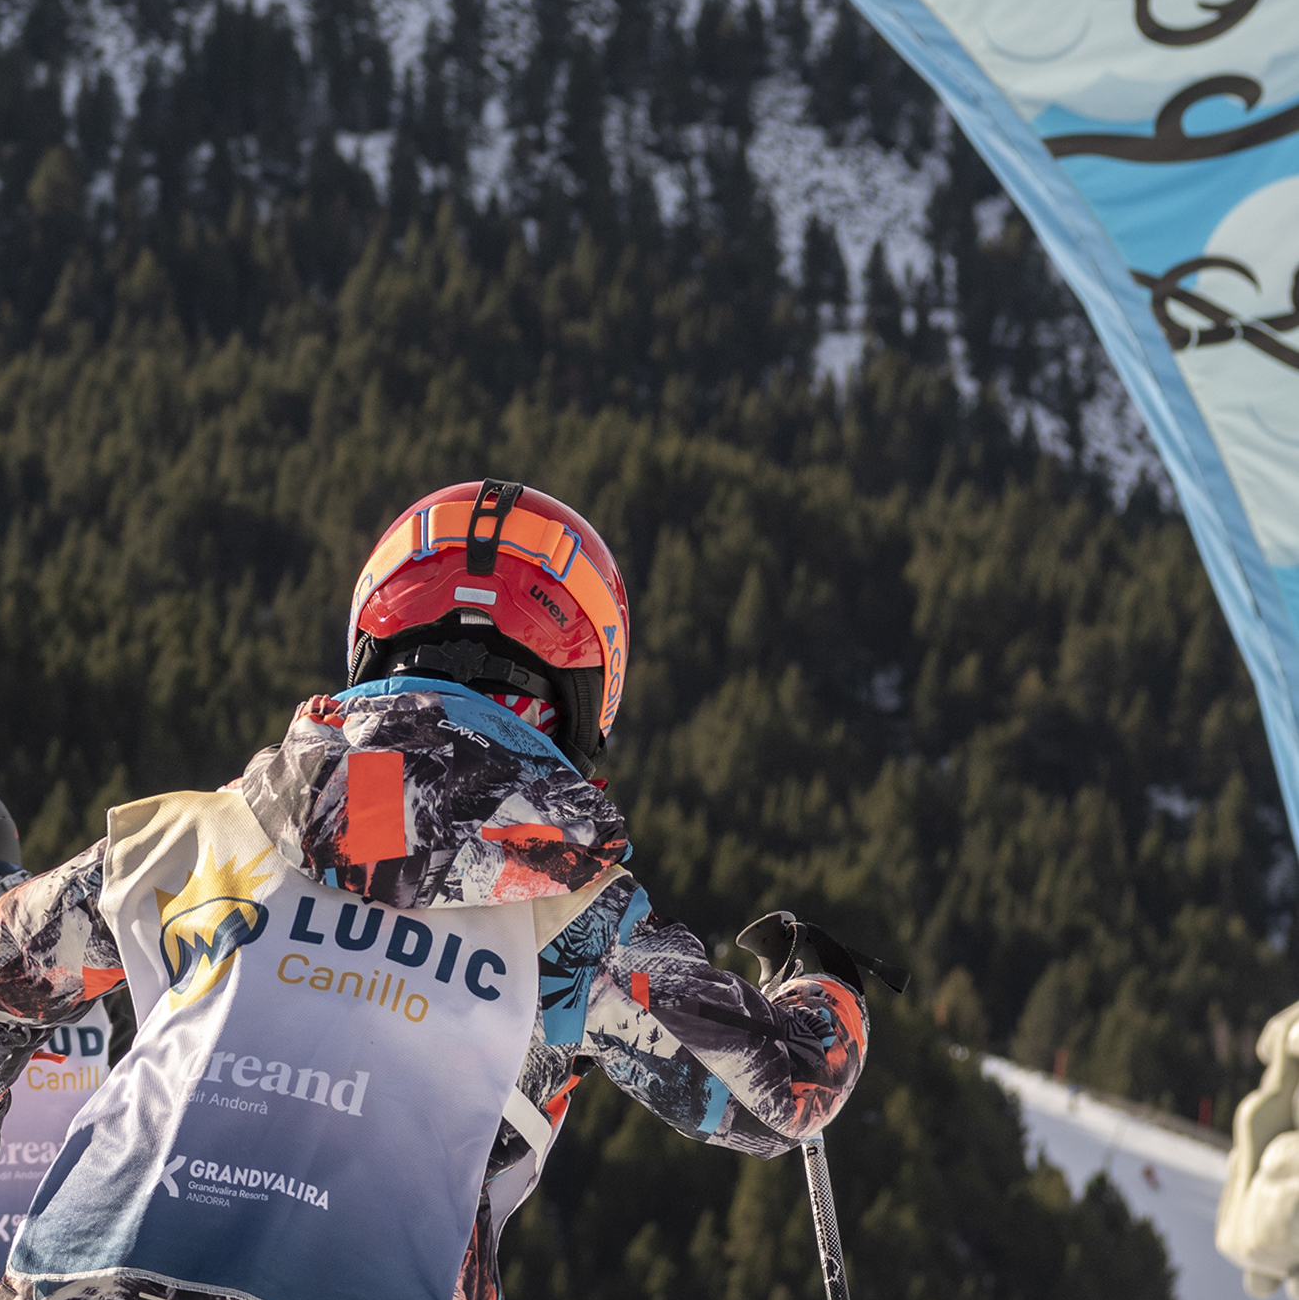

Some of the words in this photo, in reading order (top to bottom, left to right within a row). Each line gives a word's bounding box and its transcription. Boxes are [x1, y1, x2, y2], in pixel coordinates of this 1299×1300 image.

[529, 584, 570, 628] uvex
[436, 718, 491, 749] CMP
[289, 895, 507, 1000] LUDIC
[276, 952, 430, 1023] Canillo
[27, 1065, 105, 1091] Canill
[208, 1092, 269, 1116] Andorrà
[185, 1191, 231, 1208] ANDORRA
[187, 1180, 238, 1198] Grandvalira
[239, 1188, 270, 1202] Resorts
[189, 1159, 330, 1211] GRANDVALIRA
